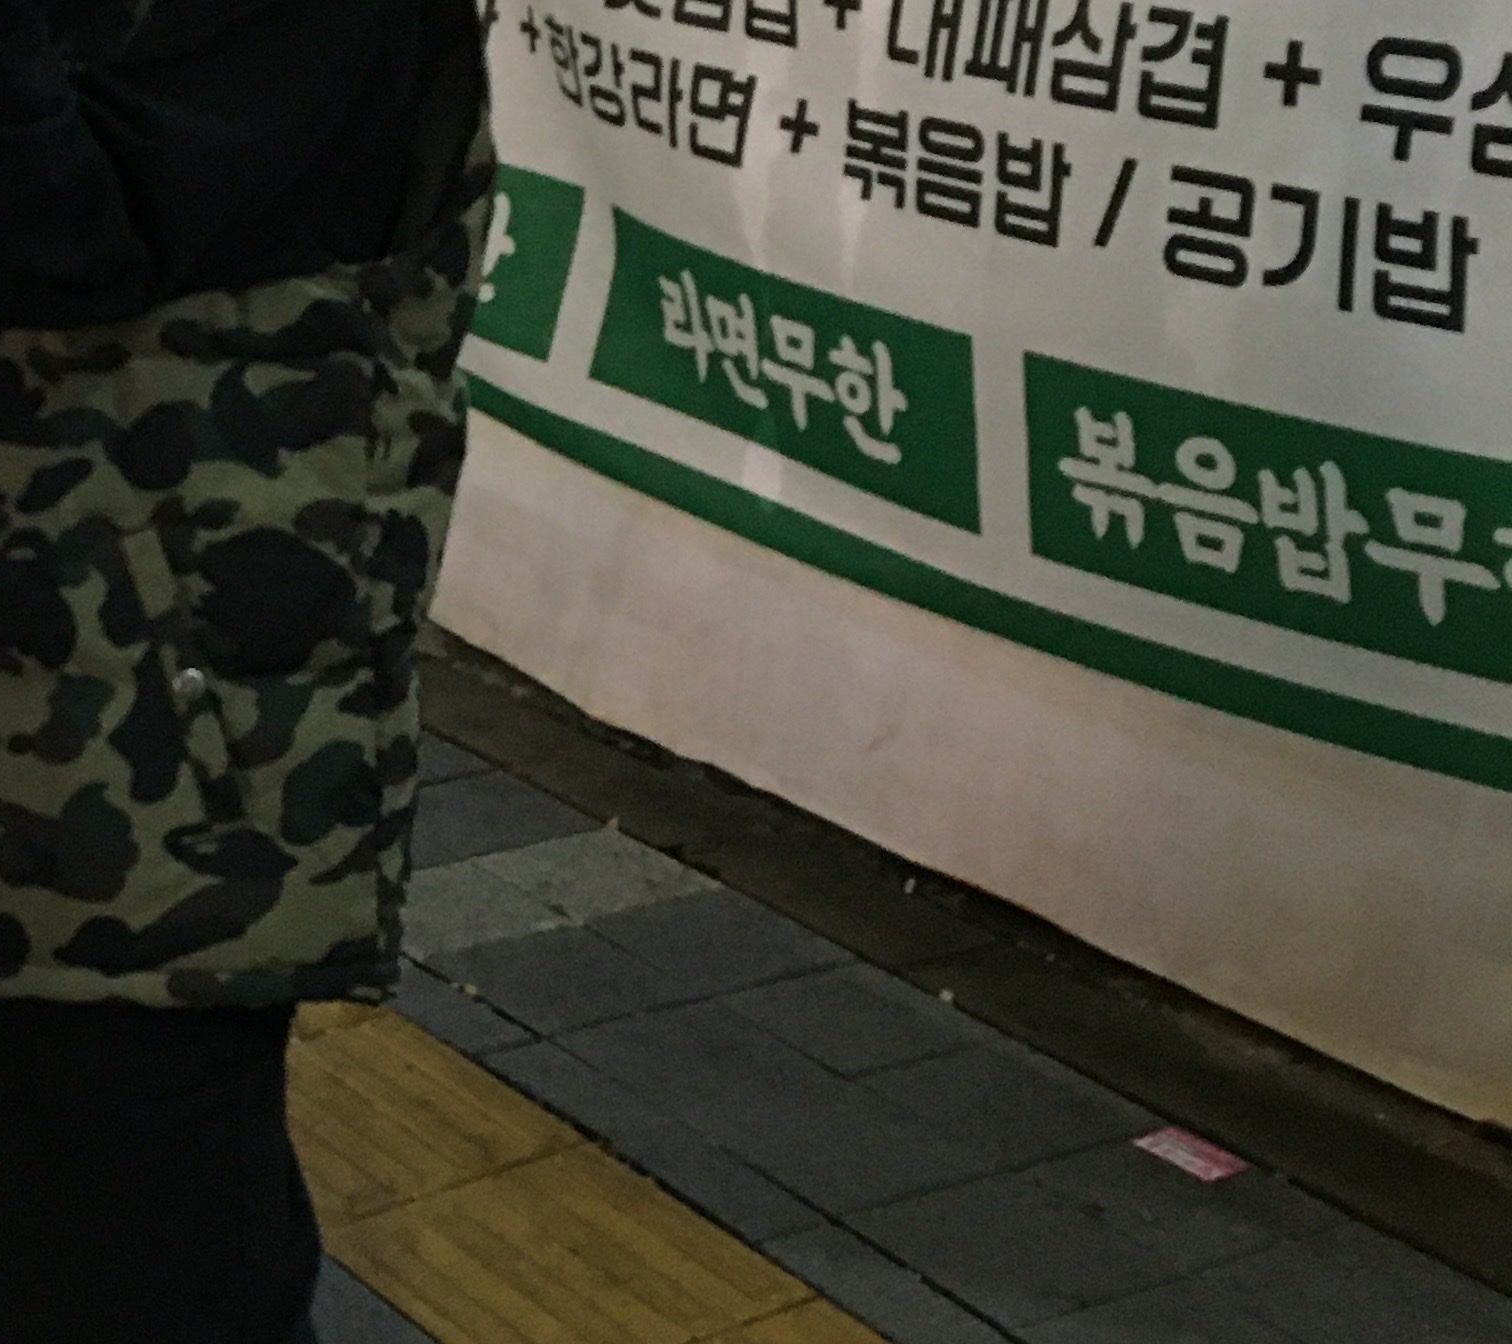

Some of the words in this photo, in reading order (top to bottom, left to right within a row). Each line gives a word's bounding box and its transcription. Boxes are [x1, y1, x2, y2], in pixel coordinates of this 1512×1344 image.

[844, 98, 1071, 247] 볶음밥
[1163, 165, 1480, 333] 공기밥
[658, 269, 908, 465] 라면무한
[1058, 405, 1512, 627] 볶음밥무
